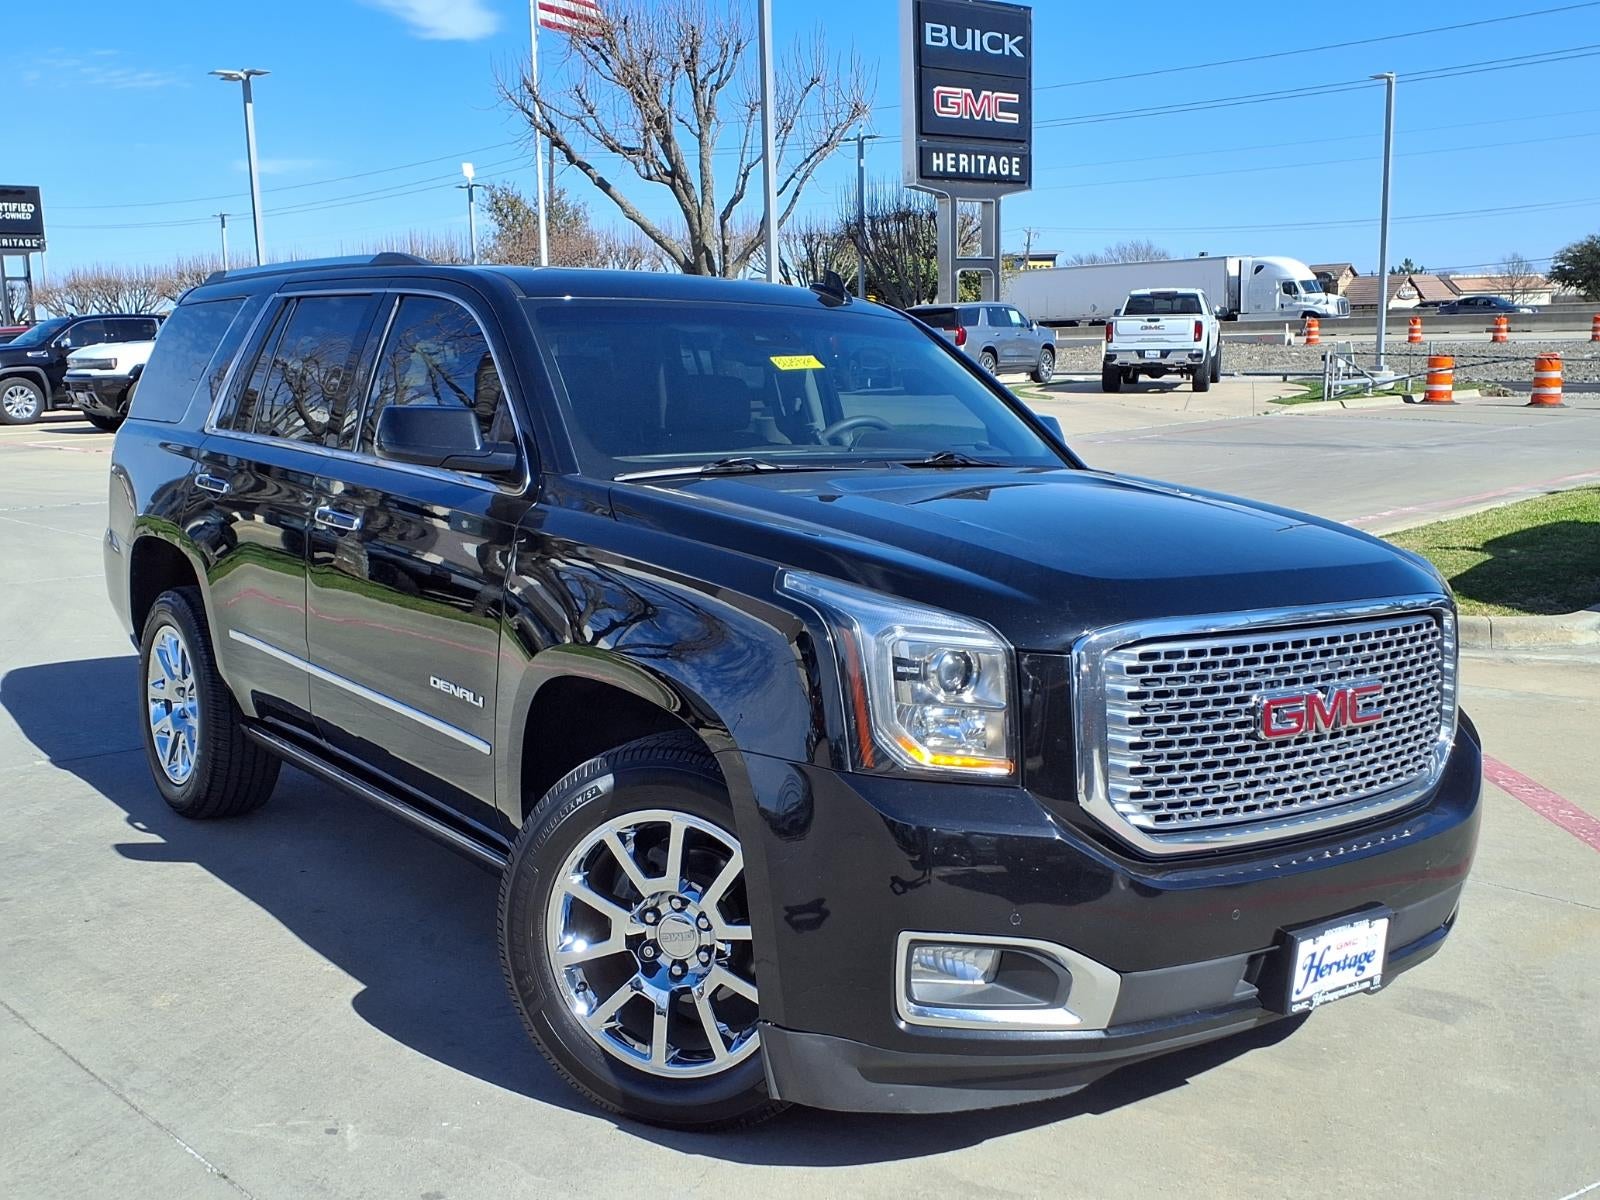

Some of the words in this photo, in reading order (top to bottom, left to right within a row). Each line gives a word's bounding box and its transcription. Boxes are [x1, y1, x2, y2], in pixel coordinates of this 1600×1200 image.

[925, 22, 1024, 58] BUICK
[934, 85, 1019, 124] GMC
[932, 152, 1020, 176] HERITAGE
[0, 238, 38, 247] RITAGE
[430, 675, 484, 708] DENALI
[1253, 680, 1384, 740] GMC
[1295, 945, 1377, 995] Heritage
